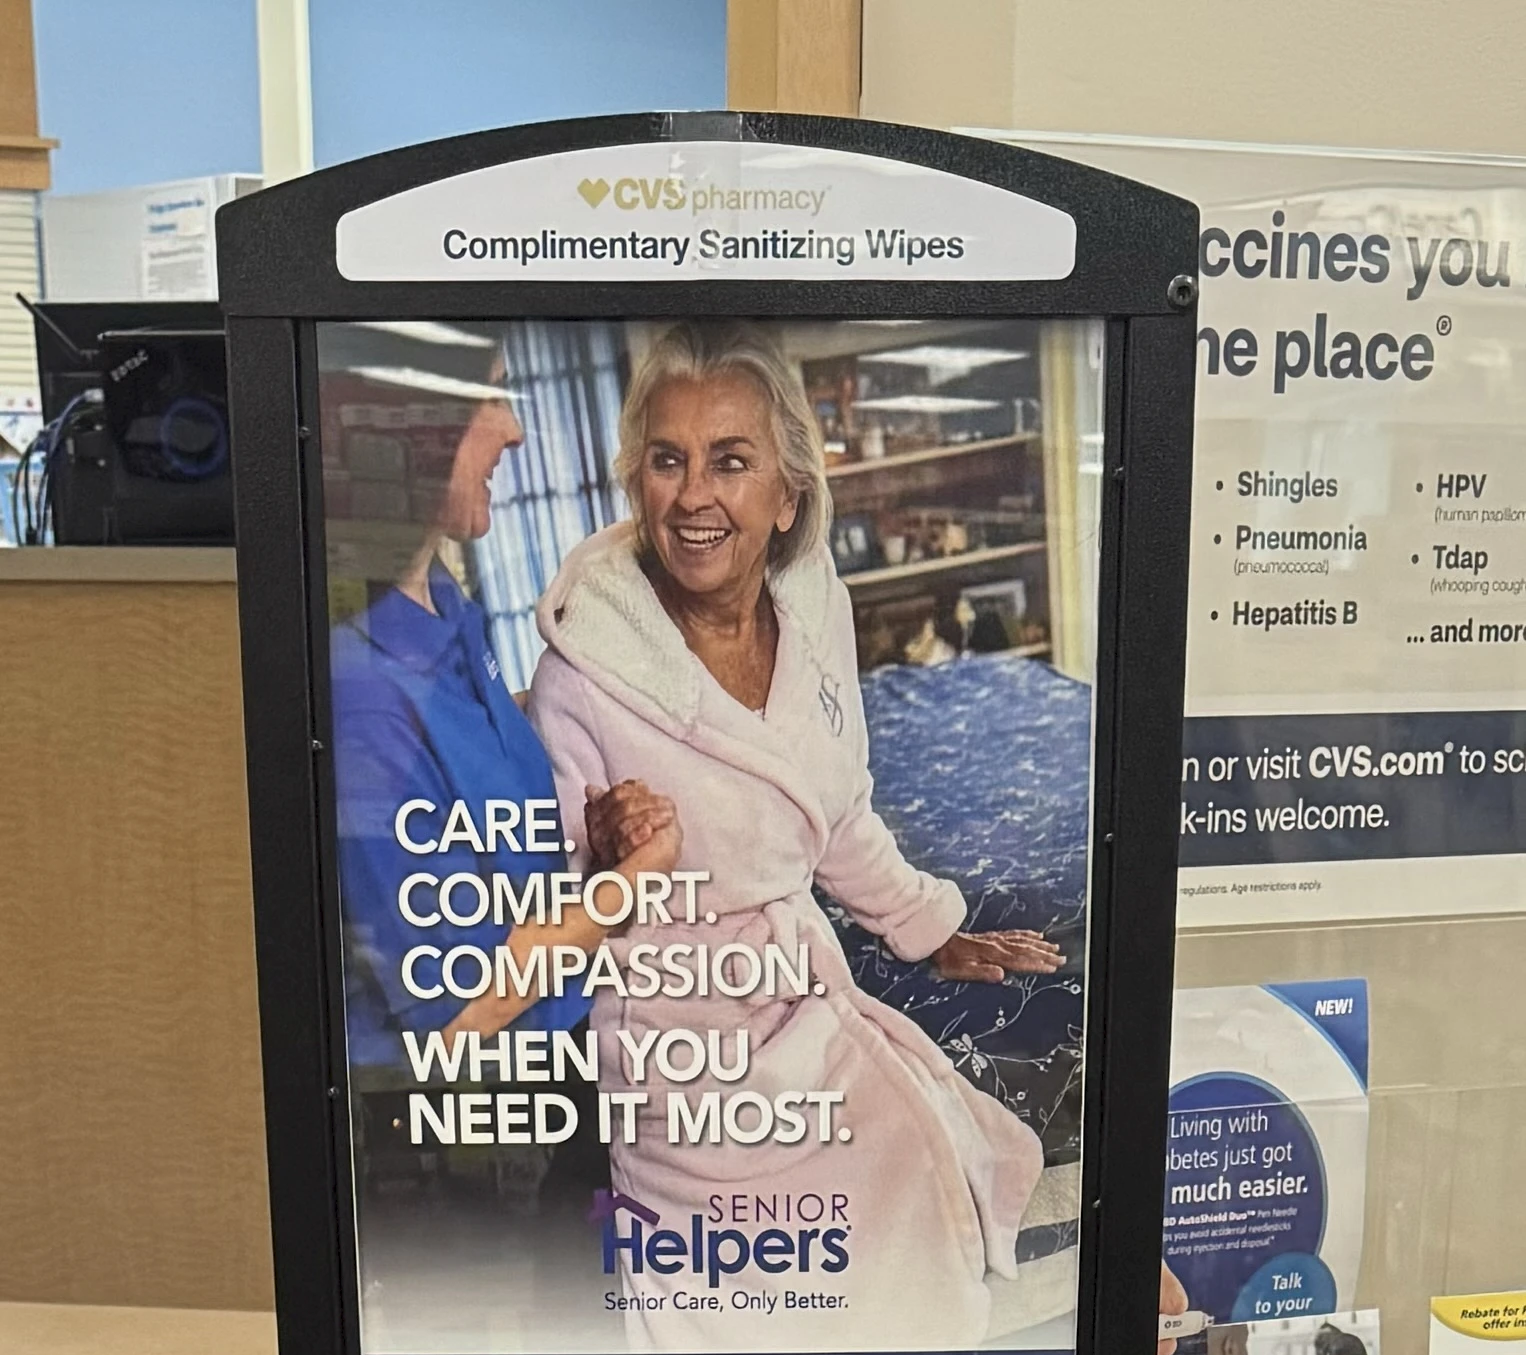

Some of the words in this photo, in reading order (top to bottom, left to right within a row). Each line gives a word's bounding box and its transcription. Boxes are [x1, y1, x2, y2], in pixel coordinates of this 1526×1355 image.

[613, 177, 685, 211] CVS
[691, 184, 826, 217] pharmacy
[443, 229, 690, 266] Complimentary
[698, 229, 855, 265] Sanitizing
[865, 228, 964, 265] Wipes
[1199, 210, 1390, 283] ccines
[1406, 237, 1511, 300] you
[1237, 471, 1338, 503] Shingles
[1436, 473, 1487, 499] HPV
[1235, 524, 1367, 551] Pneumonia
[1432, 544, 1488, 575] Tdap
[1232, 599, 1337, 632] Hepatitis
[1342, 600, 1358, 625] B
[1430, 618, 1473, 643] and
[1208, 755, 1238, 782] or
[1246, 747, 1302, 780] visit
[1459, 745, 1486, 774] to
[395, 799, 576, 854] CARE.
[1180, 801, 1247, 834] k-ins
[1255, 798, 1390, 832] welcome.
[399, 871, 718, 926] COMFORT.
[401, 943, 826, 999] COMPASSION.
[1315, 998, 1354, 1016] NEW!
[402, 1030, 598, 1082] WHEN
[617, 1029, 749, 1082] YOU
[410, 1094, 579, 1145] NEED
[600, 1093, 648, 1144] IT
[669, 1091, 853, 1144] MOST.
[1170, 1114, 1222, 1141] Living
[1228, 1109, 1268, 1132] with
[1223, 1144, 1256, 1172] just
[1262, 1142, 1292, 1168] got
[1171, 1176, 1232, 1204] much
[1239, 1171, 1308, 1198] easier.
[708, 1193, 848, 1222] SENIOR
[1272, 1272, 1302, 1290] Talk
[604, 1291, 667, 1311] Senior
[674, 1292, 723, 1312] Care,
[731, 1291, 778, 1315] Only
[785, 1291, 848, 1309] Better.
[1255, 1300, 1271, 1314] to
[1275, 1297, 1313, 1316] your
[1460, 1308, 1500, 1319] Rebate
[1503, 1306, 1520, 1316] for
[1482, 1318, 1511, 1329] offer
